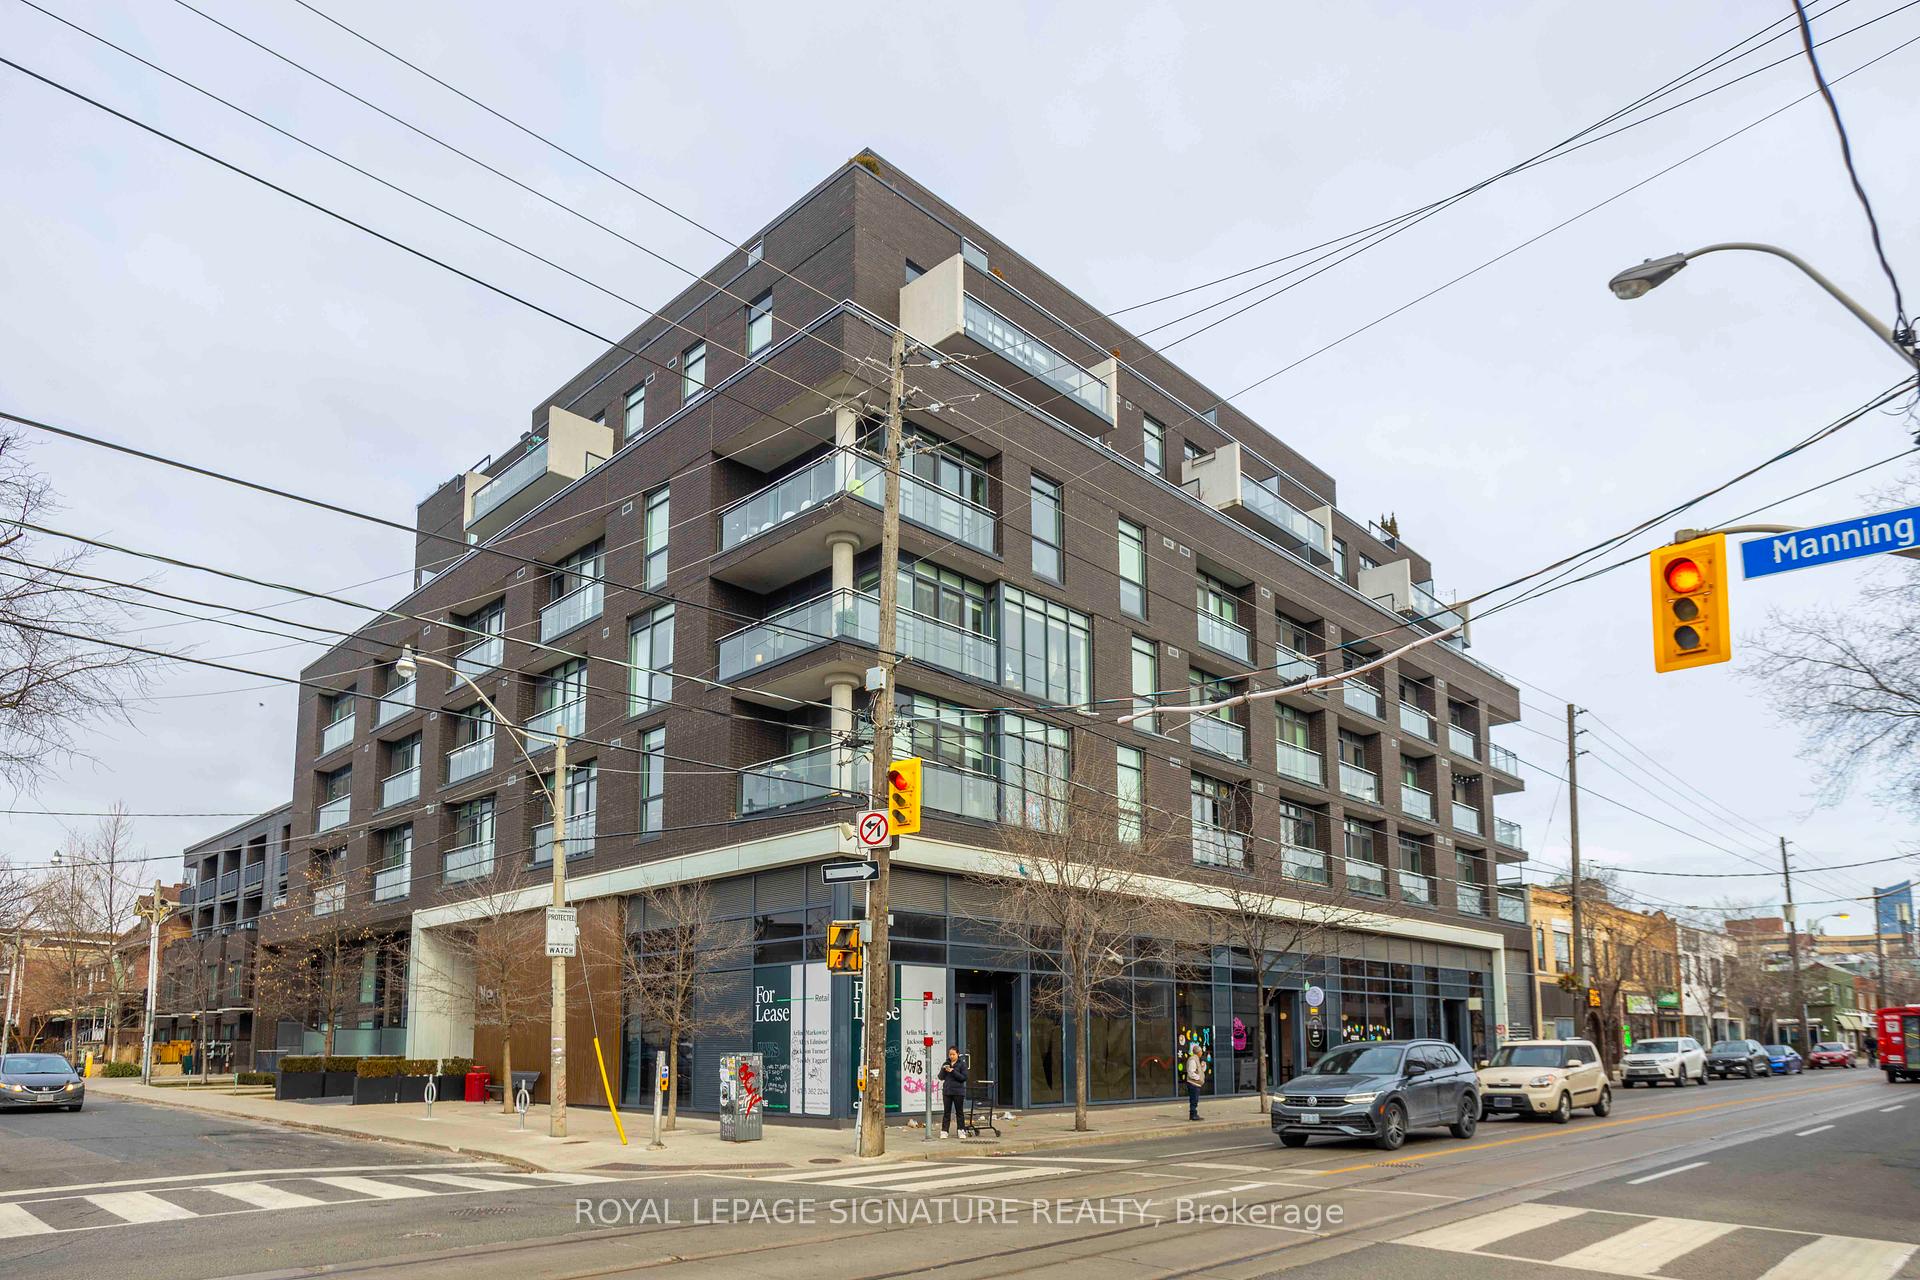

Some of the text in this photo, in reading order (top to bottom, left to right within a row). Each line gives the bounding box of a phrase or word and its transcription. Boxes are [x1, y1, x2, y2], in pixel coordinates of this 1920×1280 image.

[1773, 517, 1914, 563] Manning
[755, 986, 775, 1003] For
[815, 994, 830, 1002] Retail
[755, 1004, 790, 1022] Lease
